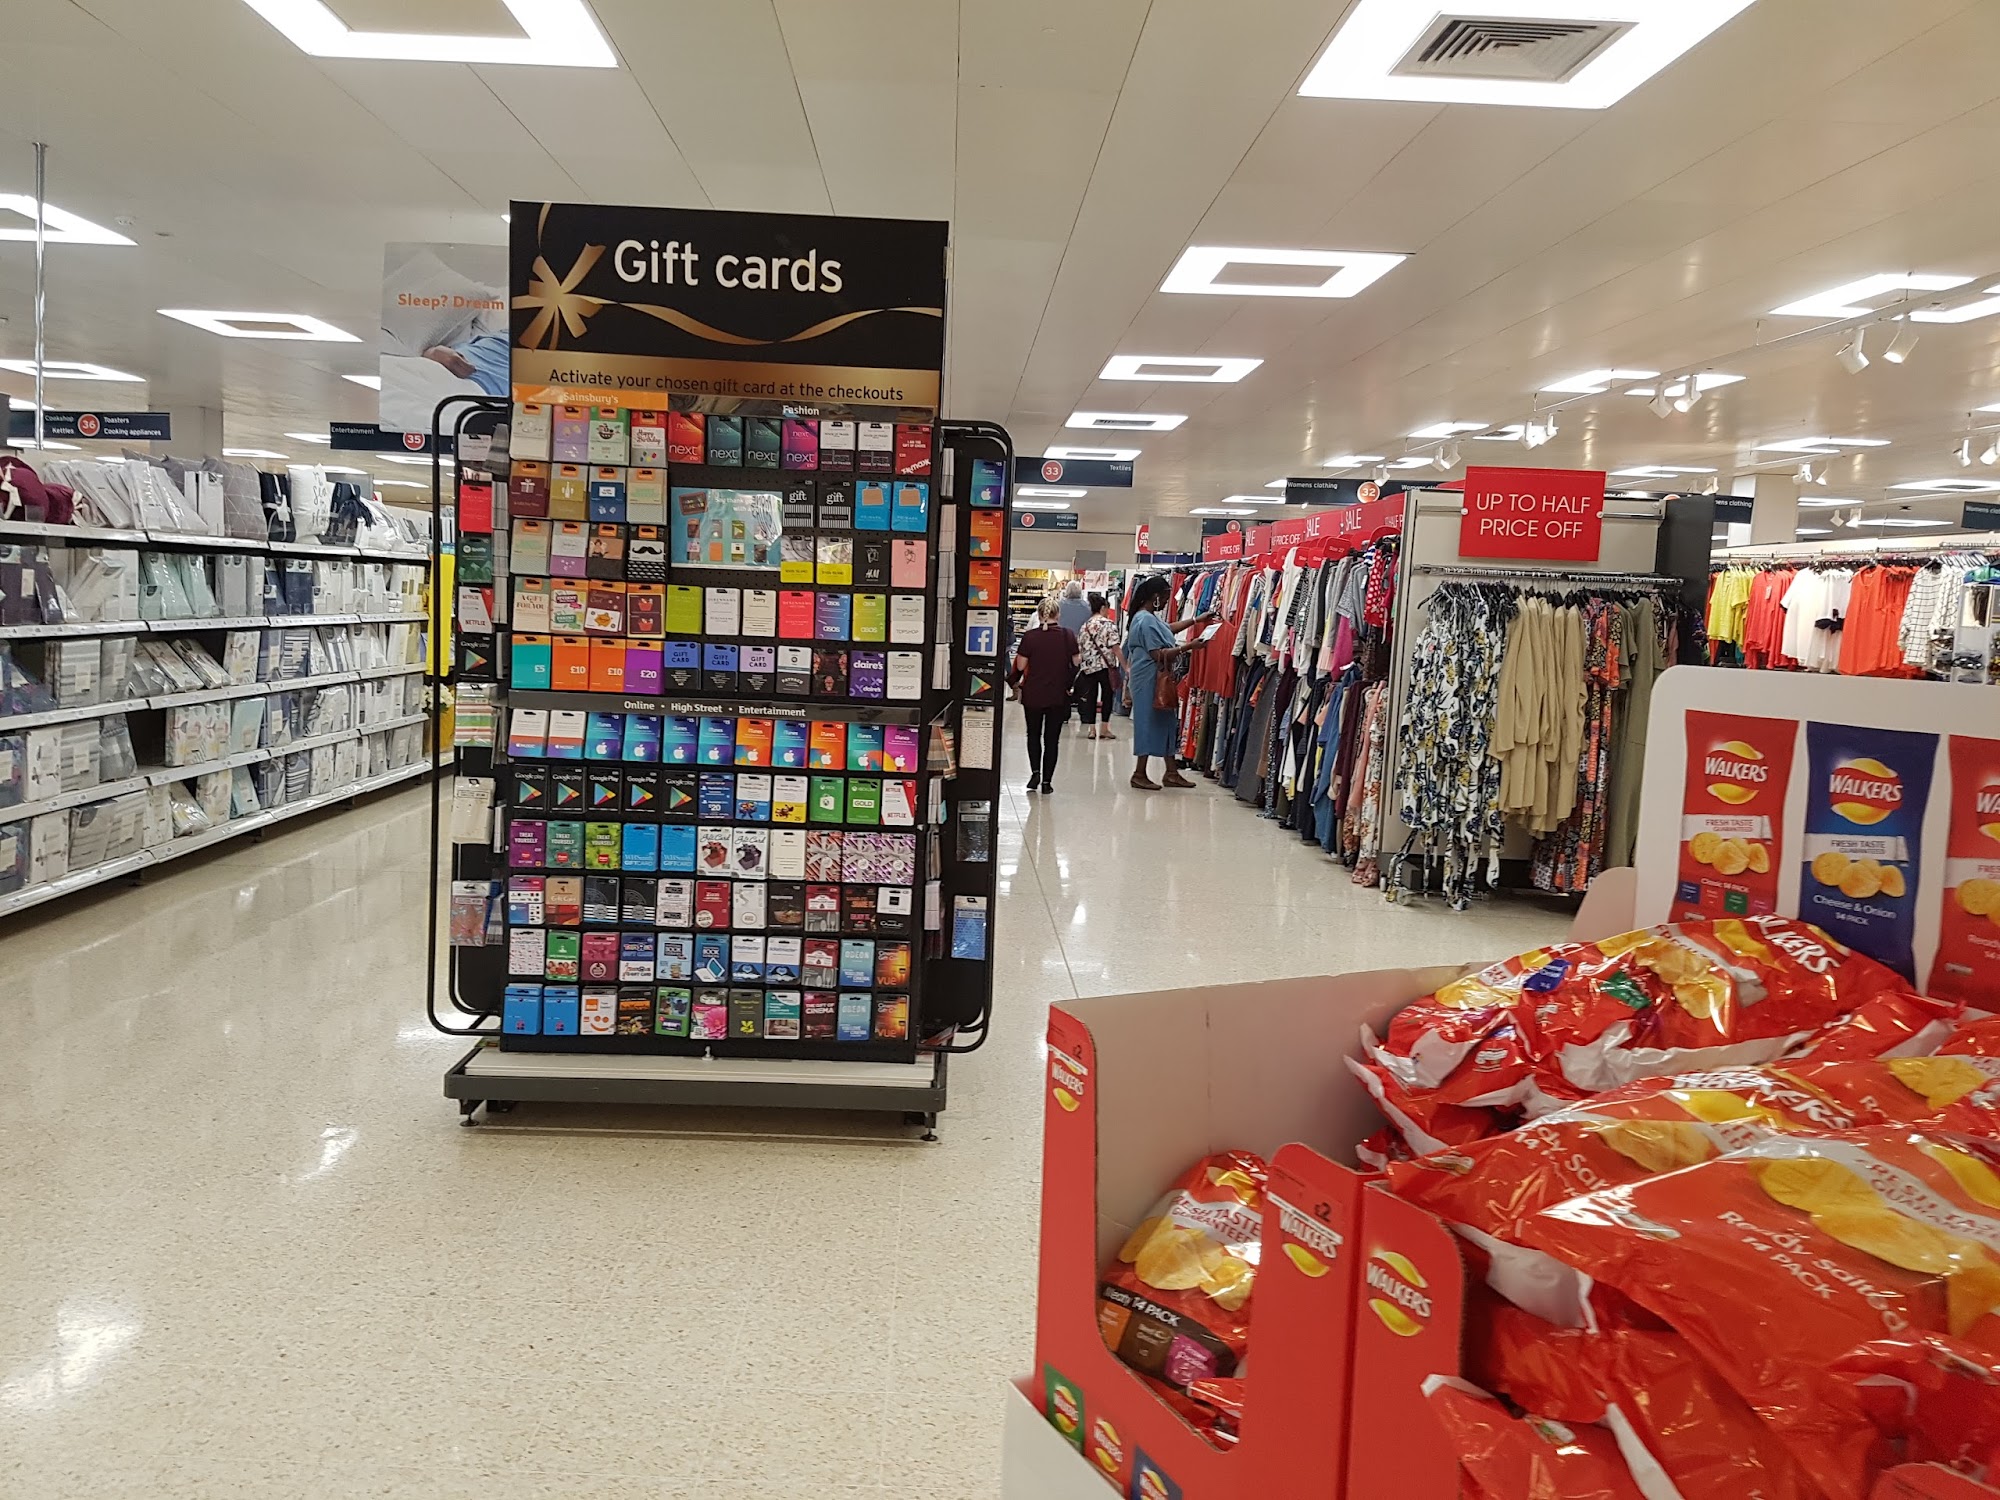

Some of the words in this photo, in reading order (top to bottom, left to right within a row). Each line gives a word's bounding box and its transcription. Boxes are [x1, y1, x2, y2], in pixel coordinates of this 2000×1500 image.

[614, 239, 699, 286] Gift
[715, 249, 844, 294] cards
[398, 293, 448, 310] Sleep?
[453, 296, 505, 311] Dream
[549, 368, 612, 385] Activate
[617, 374, 652, 389] your
[655, 374, 709, 391] chosen
[713, 377, 738, 395] gift
[743, 380, 775, 395] card
[780, 383, 796, 395] at
[800, 384, 824, 397] the
[828, 385, 903, 401] checkouts
[562, 393, 619, 405] Sainsbury's
[783, 405, 820, 416] Fashion
[82, 420, 96, 430] 36
[104, 416, 130, 424] Toasters
[52, 427, 75, 435] Kettles
[331, 426, 375, 435] Entertainment
[407, 435, 421, 444] 35
[669, 444, 697, 455] next
[711, 449, 738, 459] next
[748, 450, 776, 461] next
[786, 452, 815, 463] next
[1045, 466, 1059, 476] 33
[1110, 464, 1131, 472] Textiles
[1288, 481, 1312, 489] Womens
[1314, 482, 1338, 490] clothing
[789, 490, 807, 504] gift
[826, 492, 845, 505] gift
[1361, 489, 1376, 497] 32
[1476, 493, 1503, 511] UP
[1509, 494, 1536, 513] TO
[1542, 496, 1590, 514] HALF
[1729, 500, 1752, 508] clothing
[1480, 519, 1538, 537] PRICE
[1544, 520, 1583, 539] OFF
[534, 665, 545, 673] £5
[570, 666, 586, 674] £10
[853, 660, 883, 670] claire's
[607, 667, 623, 676] £10
[640, 670, 657, 678] £20
[624, 701, 655, 710] Online
[671, 703, 693, 713] High
[694, 703, 723, 713] Street
[739, 705, 806, 717] Entertainment
[1705, 756, 1769, 783] WALKERS
[1829, 774, 1903, 802] WALKERS
[1813, 895, 1852, 910] Cheese
[1853, 903, 1862, 912] &
[1863, 905, 1896, 919] Onion
[1835, 912, 1846, 920] 14
[1846, 915, 1869, 925] PACK
[1052, 1061, 1084, 1095] WALKERS
[1216, 1208, 1262, 1236] TASTE
[1279, 1208, 1337, 1259] WALKERS
[1741, 1236, 1772, 1251] 14
[1771, 1253, 1839, 1299] PACK
[1366, 1261, 1432, 1318] WALKERS
[1132, 1297, 1146, 1310] 14
[1145, 1304, 1181, 1326] PACK
